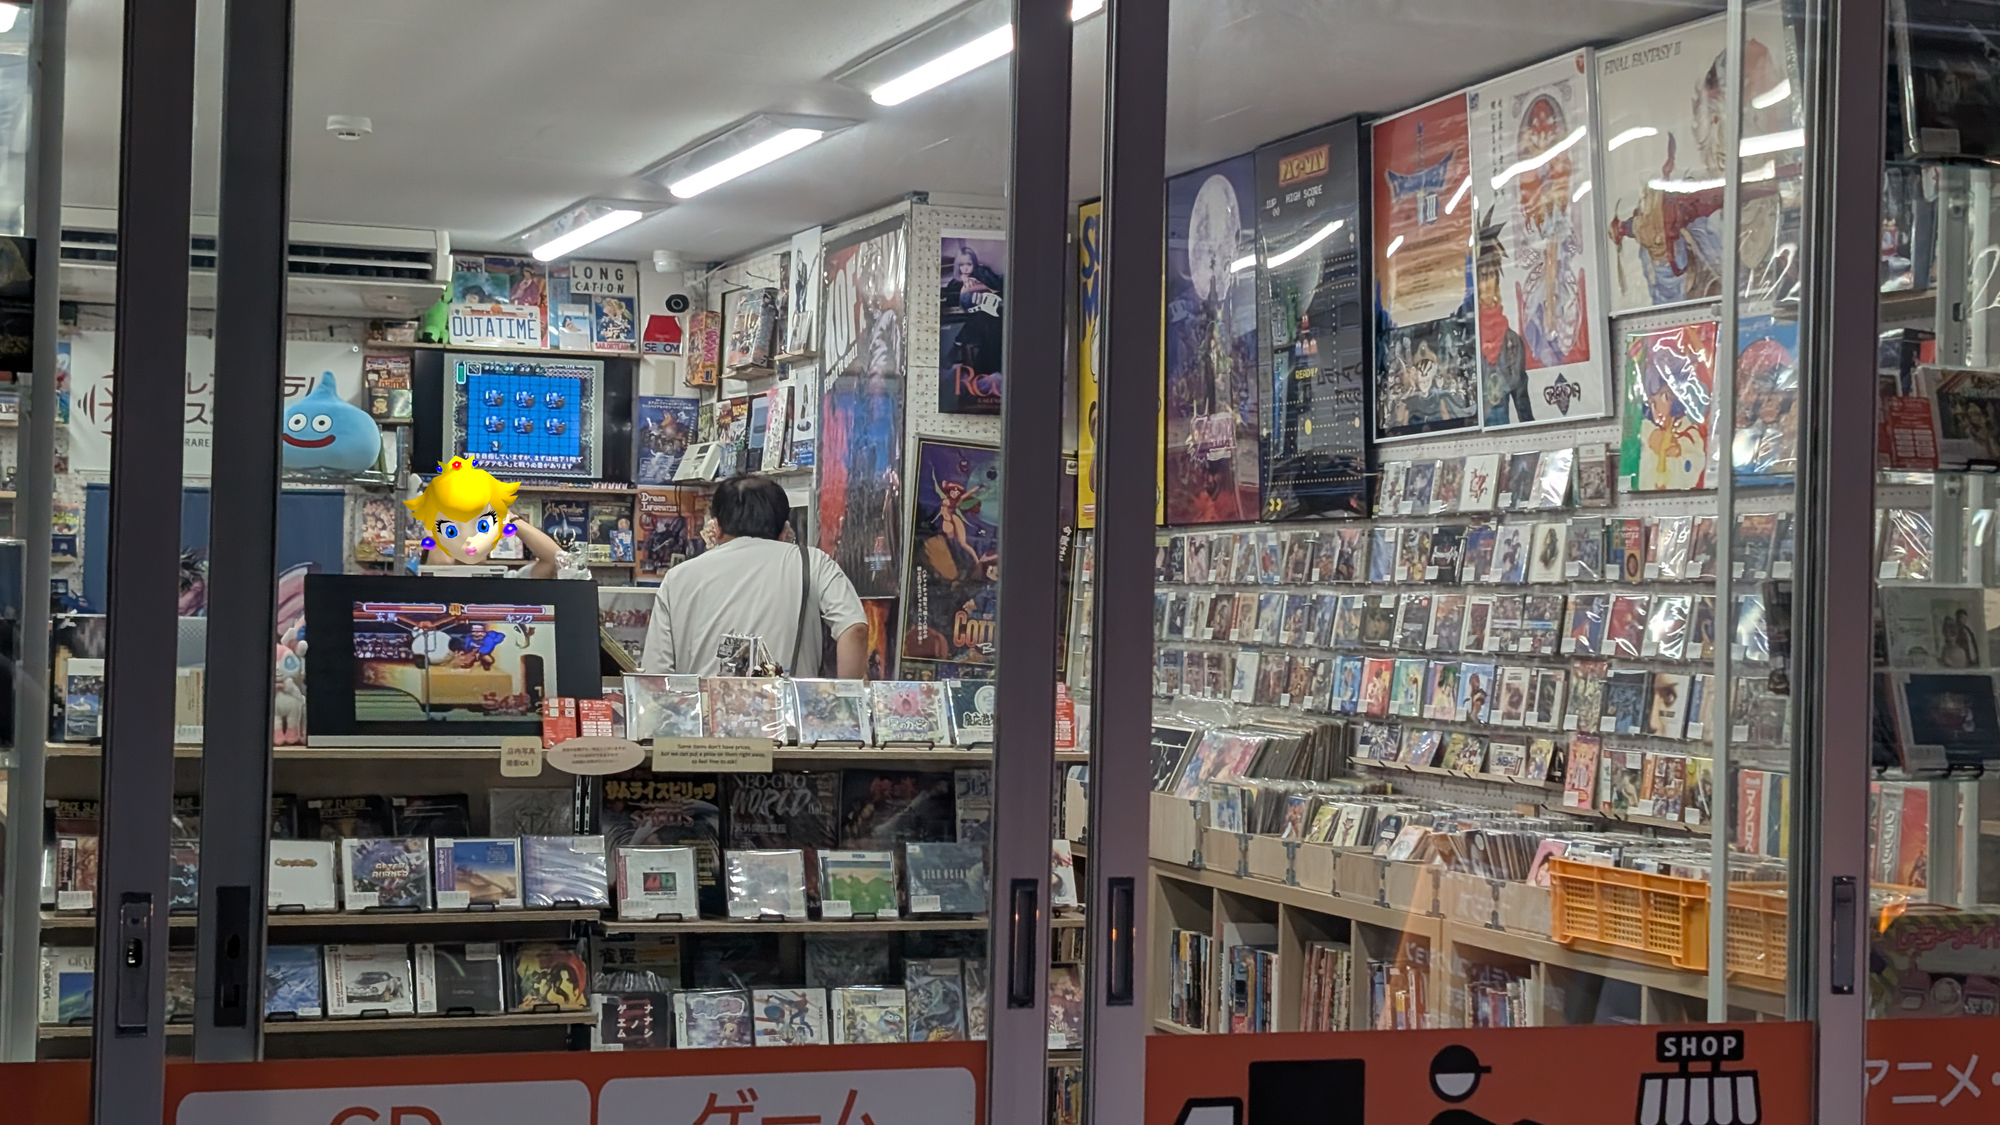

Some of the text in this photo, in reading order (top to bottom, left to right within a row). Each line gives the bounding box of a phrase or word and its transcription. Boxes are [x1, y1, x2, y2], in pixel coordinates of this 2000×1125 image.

[1604, 56, 1629, 75] FINAL
[1632, 43, 1673, 67] FANTASY
[1285, 184, 1322, 203] HIGH SCORE
[571, 266, 624, 281] LONG
[452, 316, 538, 340] OUTATIME
[605, 781, 716, 799] サムライスピリッツ
[733, 788, 812, 818] WORLD
[1745, 789, 1756, 853] マクロス
[617, 1004, 627, 1038] ゲエム
[644, 1004, 653, 1038] ナナシ
[1663, 1036, 1738, 1057] SHOP
